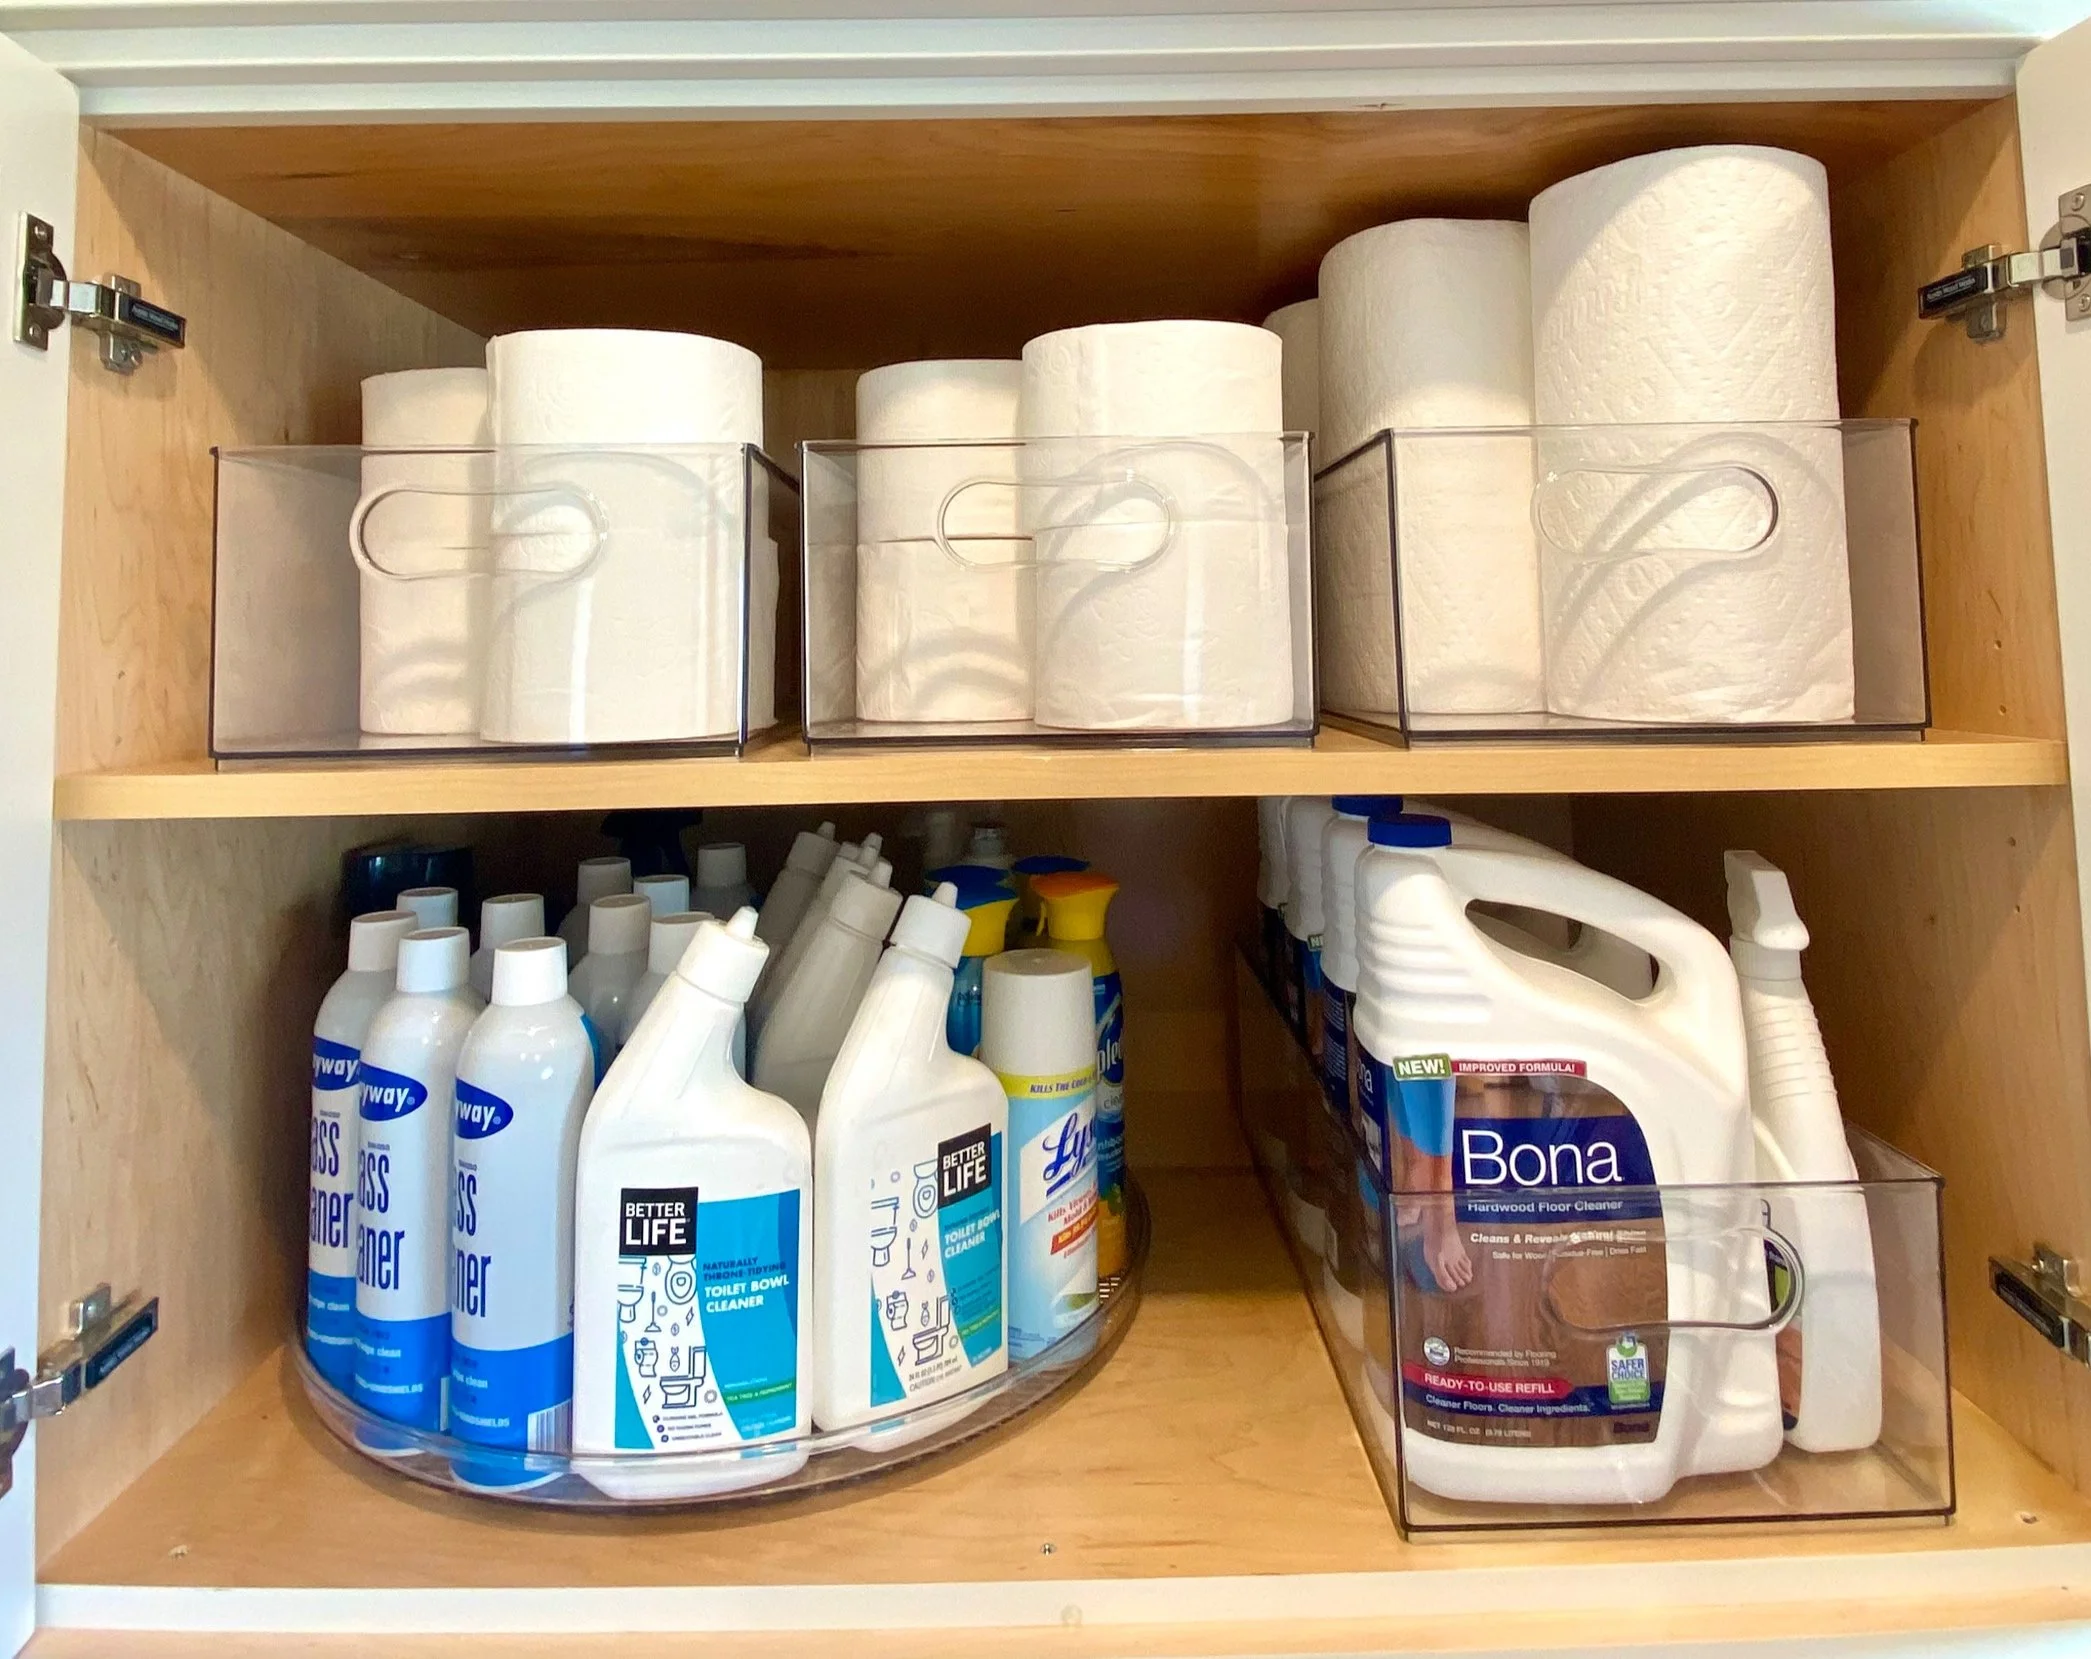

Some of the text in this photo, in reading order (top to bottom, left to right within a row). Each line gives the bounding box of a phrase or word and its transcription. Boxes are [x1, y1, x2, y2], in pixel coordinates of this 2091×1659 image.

[1399, 1059, 1446, 1076] NEW!
[1459, 1062, 1576, 1073] IMPROVED FORMULA!
[942, 1140, 986, 1171] BETTER
[1461, 1128, 1623, 1187] Bona
[943, 1155, 987, 1198] LIFE
[625, 1201, 686, 1218] BETTER
[1467, 1200, 1624, 1213] Hardwood Floor Cleaner
[625, 1217, 687, 1246] LIFE
[944, 1222, 976, 1246] TOILET
[1470, 1233, 1510, 1244] Cleans
[1513, 1233, 1521, 1244] &
[944, 1231, 986, 1259] CLEANER
[702, 1256, 759, 1271] NATURALLY
[704, 1274, 790, 1298] TOILET BOWL
[705, 1294, 764, 1313] CLEANER
[1611, 1358, 1645, 1371] SAFER
[1424, 1372, 1555, 1394] READY-TO-USE REFILL
[1611, 1370, 1644, 1381] CHOICE
[1425, 1393, 1462, 1409] Cleaner
[1497, 1403, 1534, 1414] Cleaner
